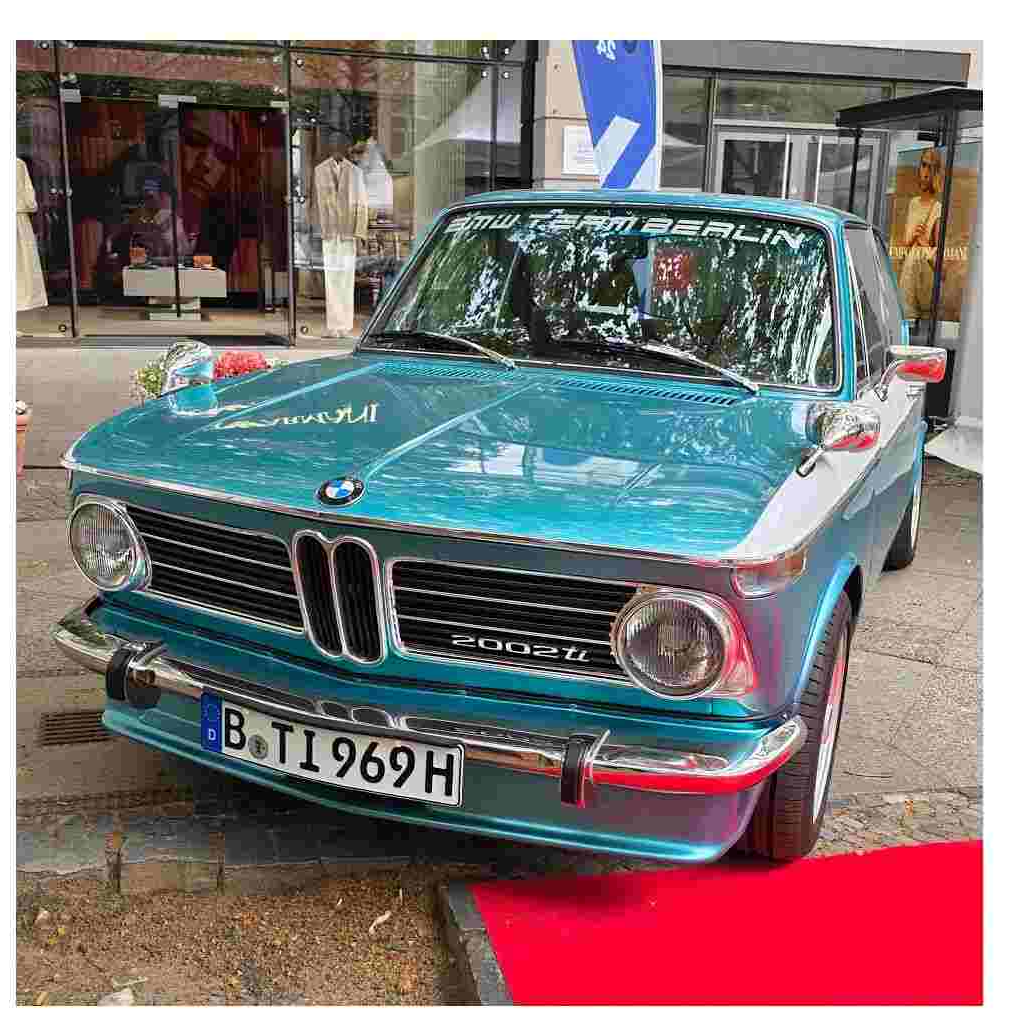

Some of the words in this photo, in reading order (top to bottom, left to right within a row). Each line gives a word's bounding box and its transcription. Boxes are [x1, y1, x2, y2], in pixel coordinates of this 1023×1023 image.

[638, 215, 806, 250] BERLIN
[226, 707, 247, 750] B
[271, 720, 321, 773] TI
